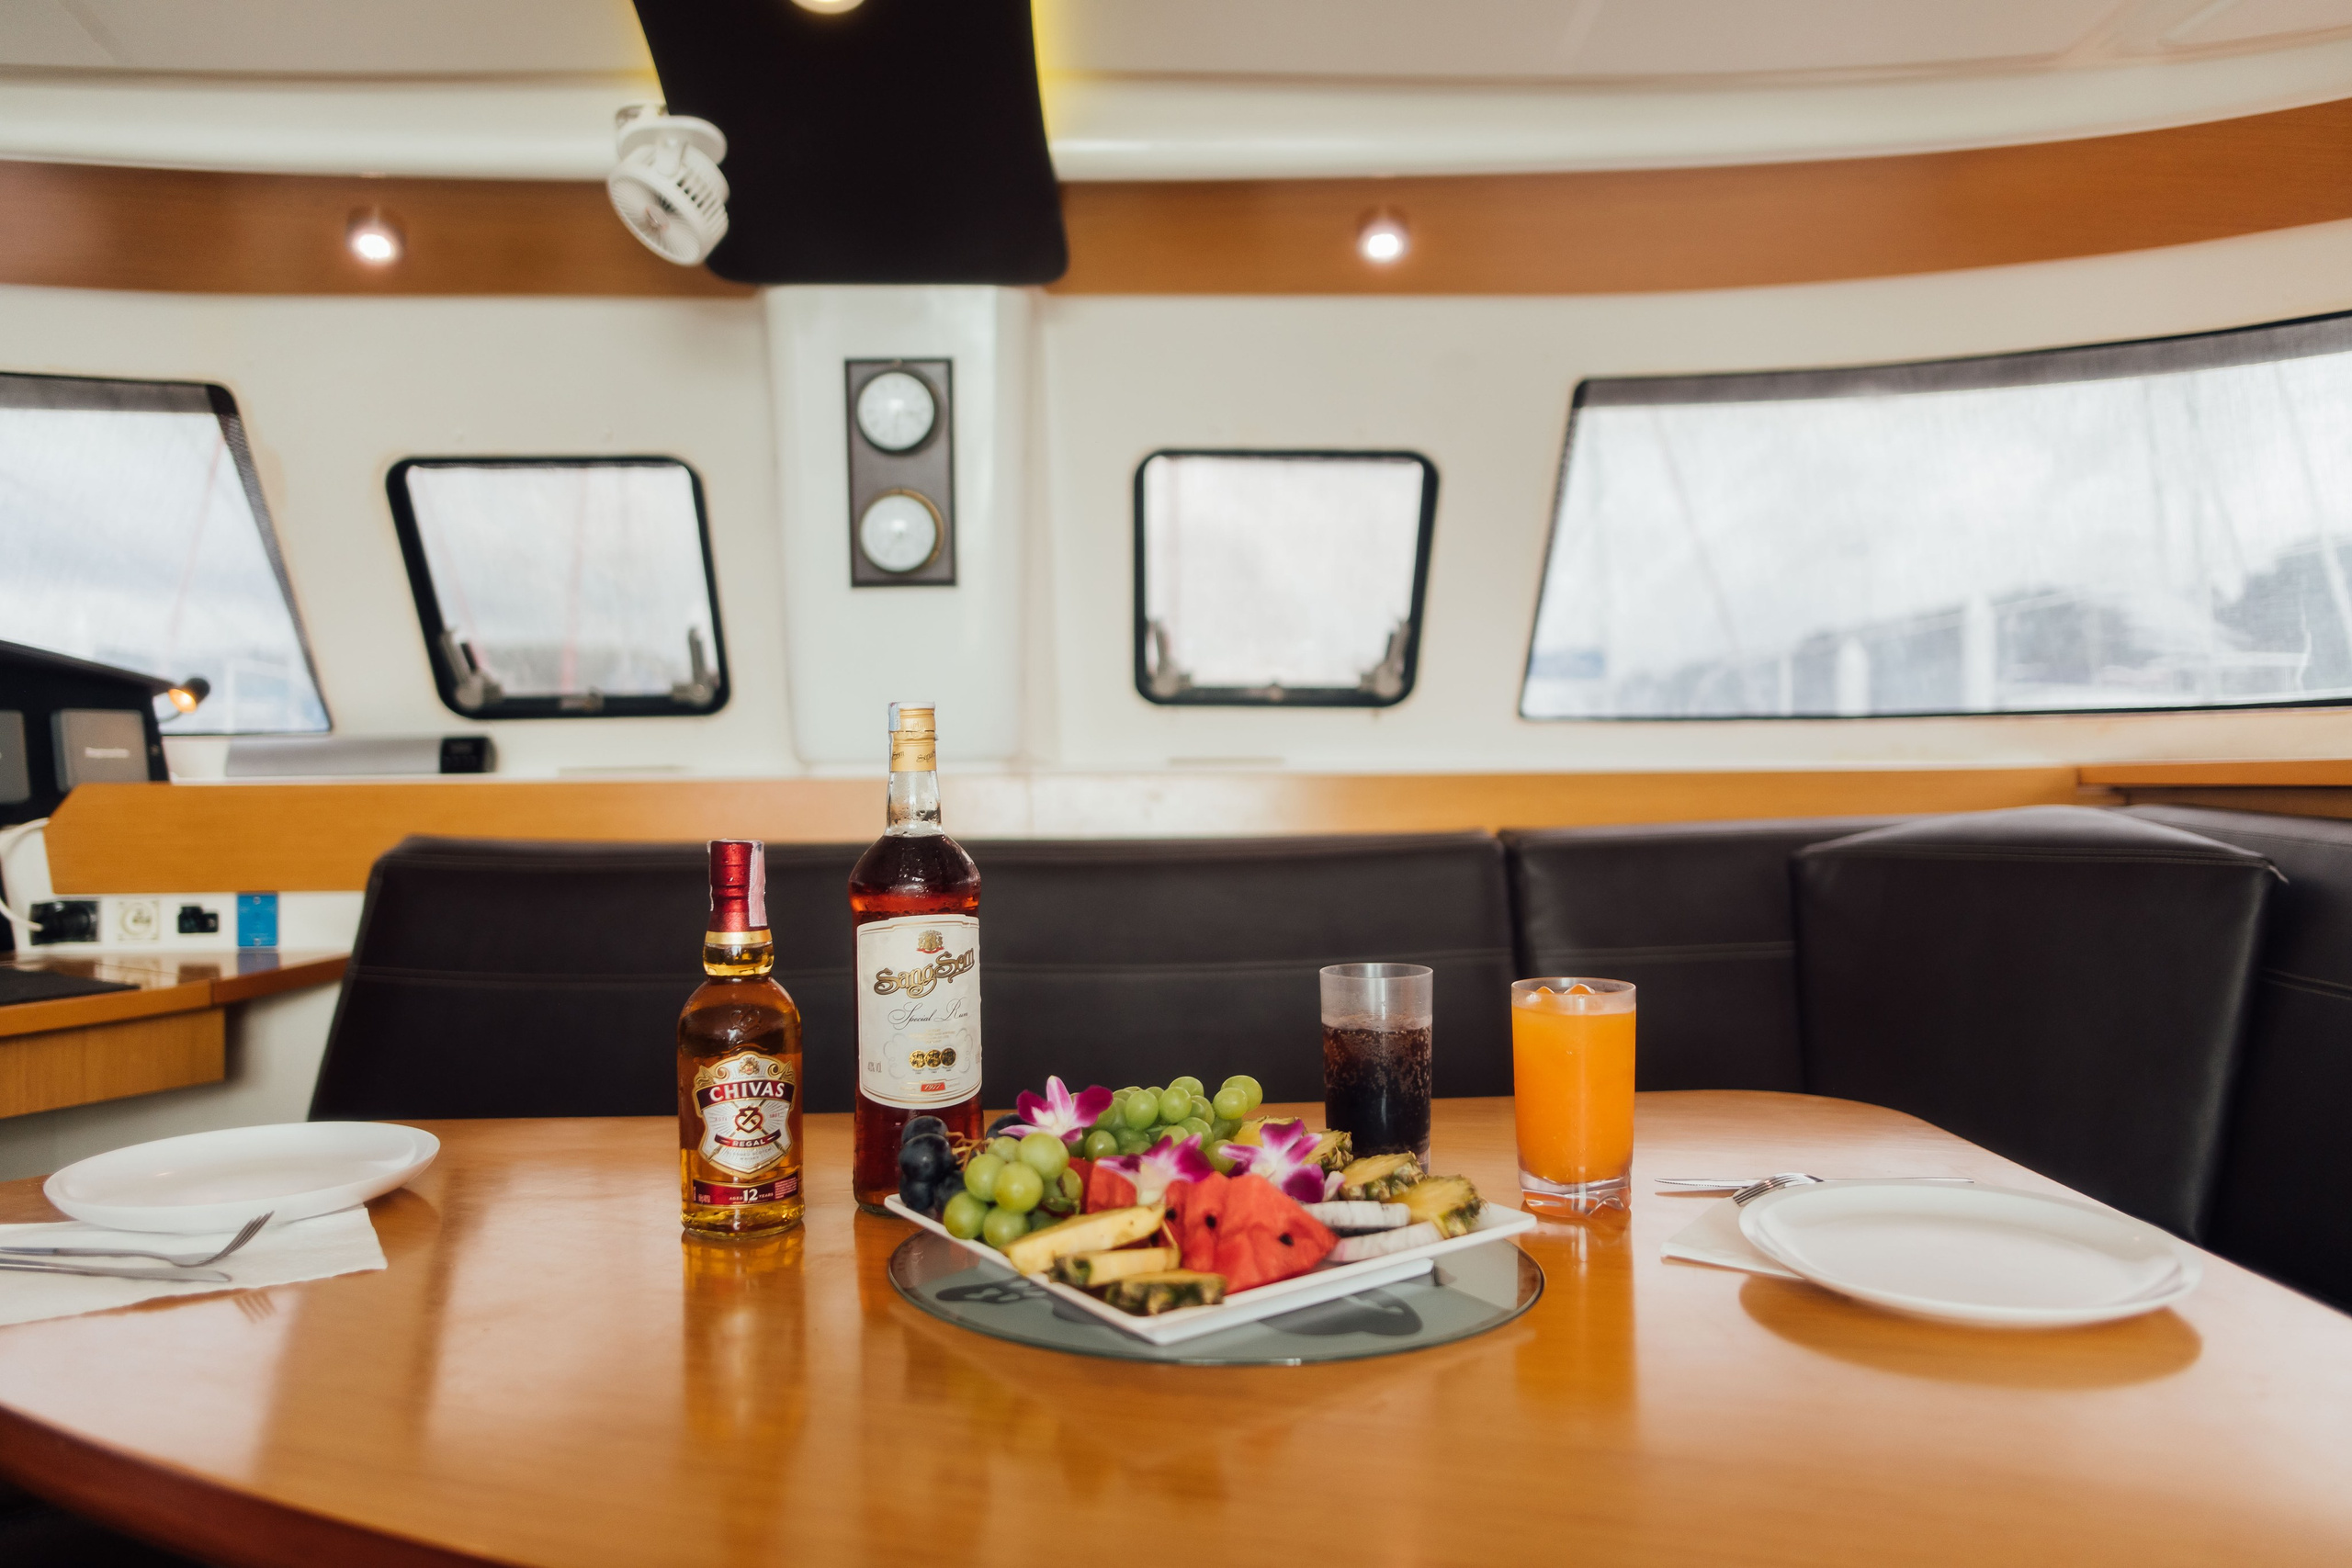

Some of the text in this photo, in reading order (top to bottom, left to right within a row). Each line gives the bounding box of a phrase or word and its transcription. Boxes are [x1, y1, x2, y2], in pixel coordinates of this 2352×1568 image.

[888, 997, 968, 1031] Special Rum
[709, 1081, 785, 1101] CHIVAS
[732, 1139, 766, 1147] REGAL
[742, 1188, 759, 1202] 12
